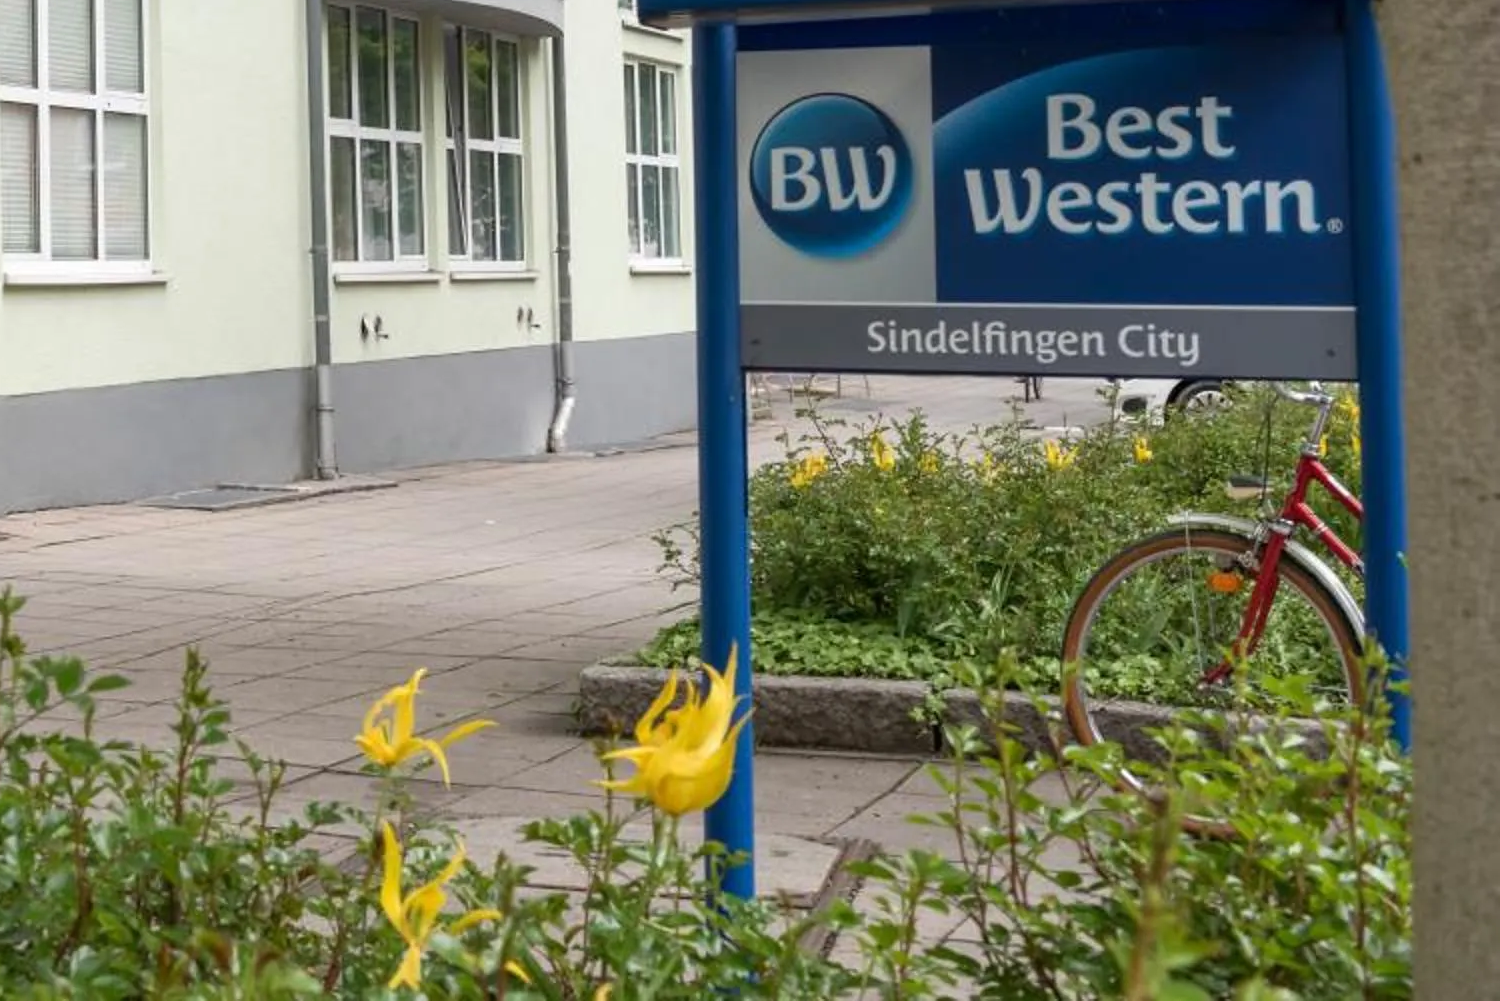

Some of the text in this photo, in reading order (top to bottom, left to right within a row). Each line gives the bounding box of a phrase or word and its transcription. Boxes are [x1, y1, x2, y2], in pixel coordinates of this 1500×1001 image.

[1045, 93, 1235, 160] Best
[770, 146, 897, 212] BW
[964, 168, 1321, 235] Western
[866, 320, 1201, 367] Sindelfingen City
